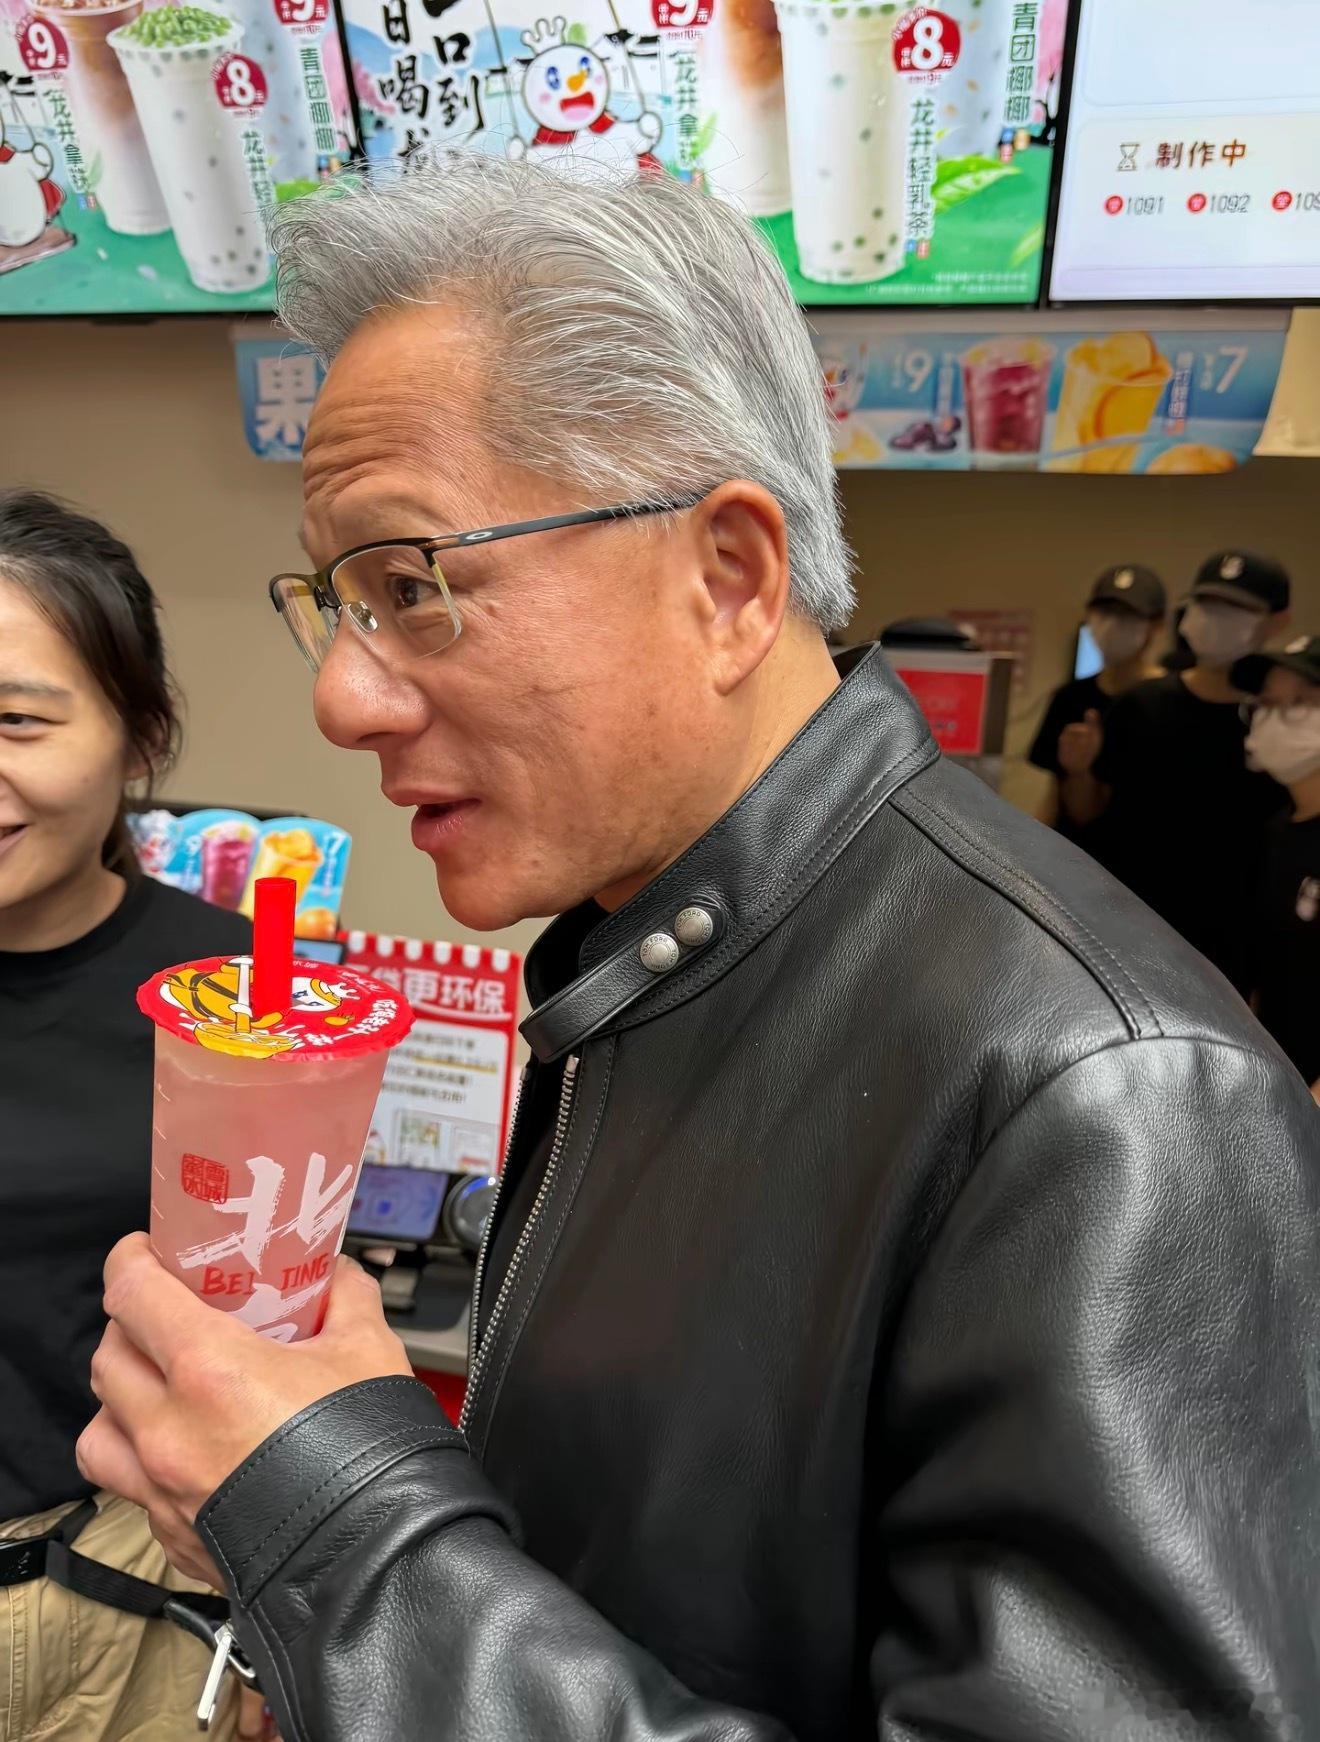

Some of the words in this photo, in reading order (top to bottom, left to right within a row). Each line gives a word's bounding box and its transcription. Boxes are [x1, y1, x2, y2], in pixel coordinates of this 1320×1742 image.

[28, 21, 57, 69] 9
[911, 15, 944, 70] 8
[226, 58, 256, 106] 8
[1155, 138, 1247, 169] 制作中
[1126, 196, 1165, 216] 1091
[1210, 194, 1250, 214] 1092
[904, 350, 933, 393] 9
[1217, 346, 1248, 393] 7
